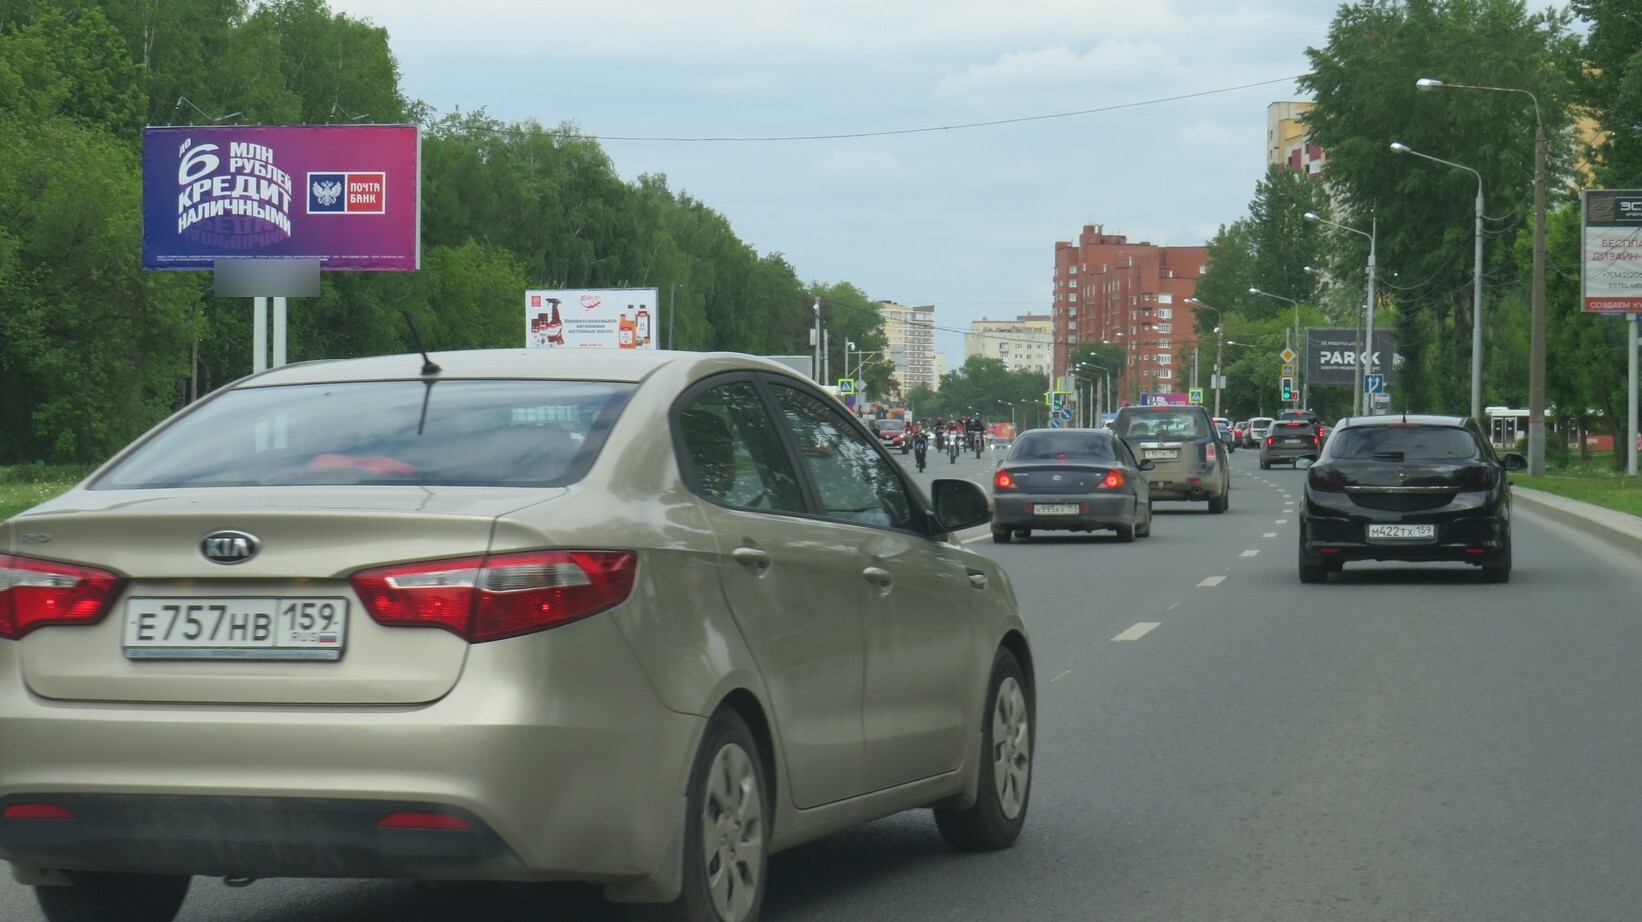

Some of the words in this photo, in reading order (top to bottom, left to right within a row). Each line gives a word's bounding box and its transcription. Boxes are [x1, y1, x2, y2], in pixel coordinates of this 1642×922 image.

[178, 137, 192, 158] ДО
[178, 143, 220, 186] 6
[229, 141, 274, 165] МЛН
[229, 157, 292, 197] РУБЛЕЙ
[178, 175, 292, 215] КРЕДИТ
[350, 182, 381, 193] ПОЧТА
[350, 194, 377, 205] БАНК
[1620, 201, 1642, 212] ЭС
[178, 198, 292, 238] НАЛИЧНЫМИ
[1589, 301, 1631, 310] СОЗДАЕМ
[1371, 526, 1413, 537] М422ТХ
[1415, 525, 1432, 534] 159
[206, 537, 249, 557] KIA
[136, 604, 271, 641] Е757НВ
[282, 602, 335, 631] 159
[291, 631, 318, 642] RUS
